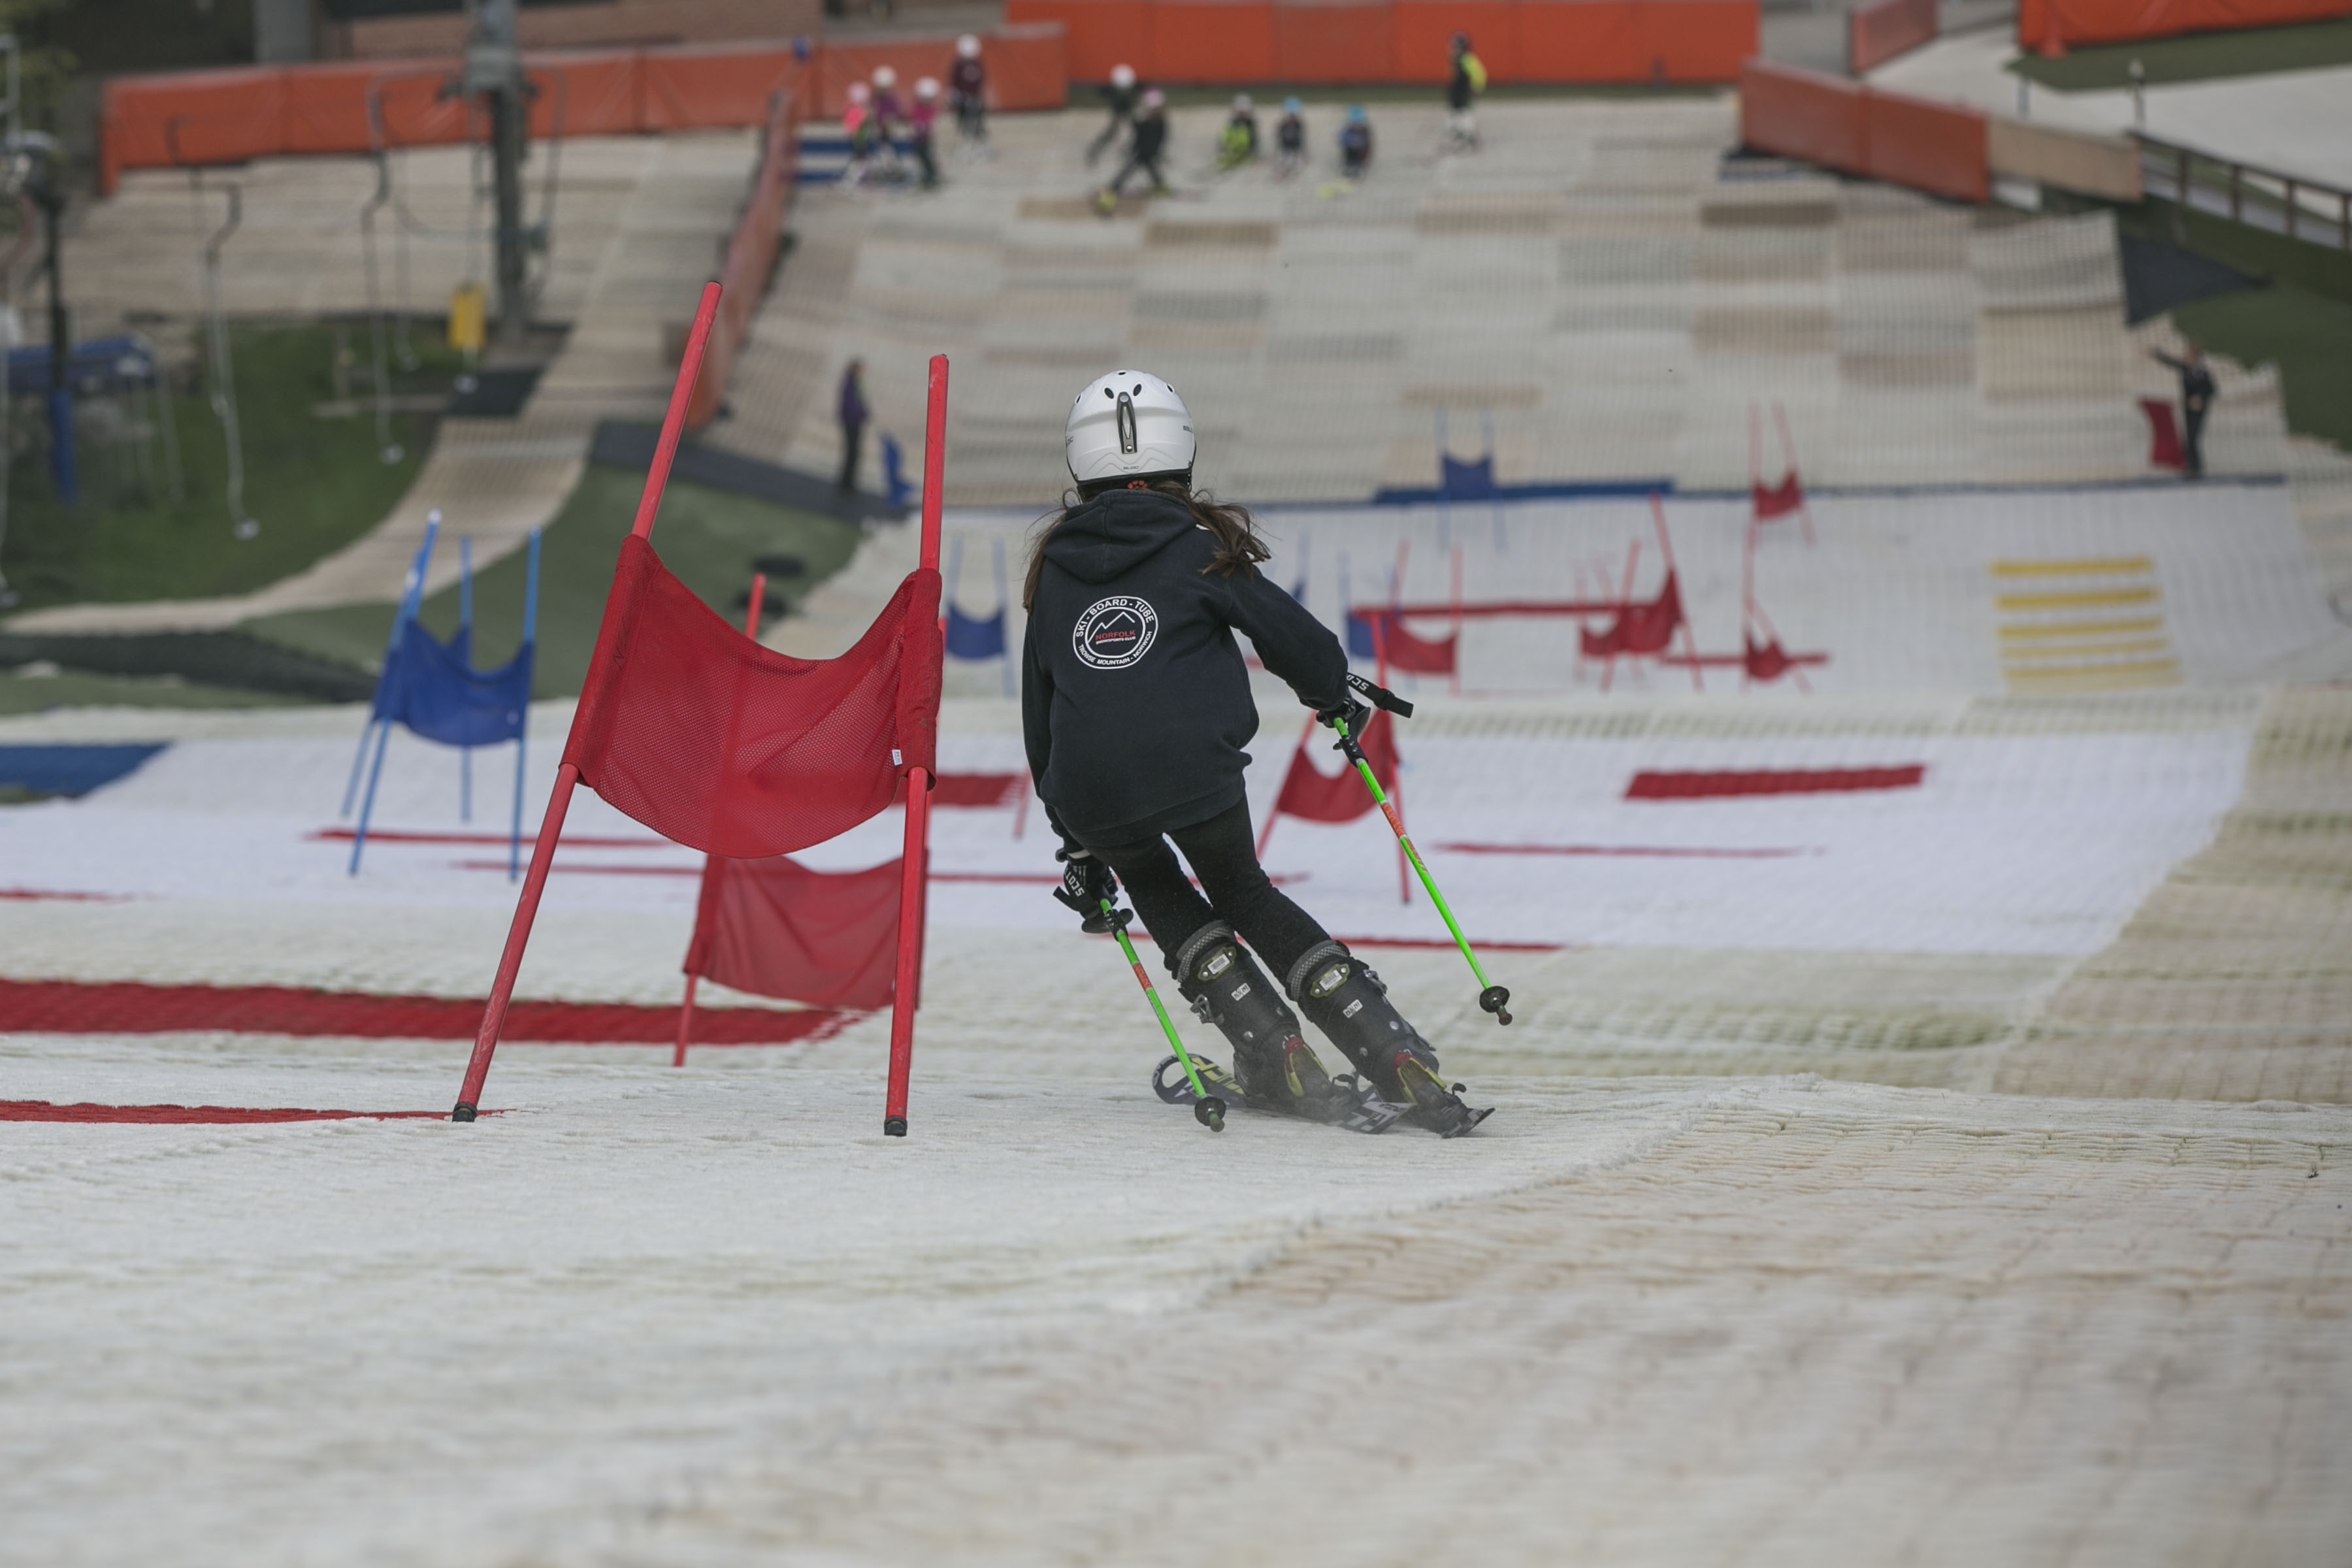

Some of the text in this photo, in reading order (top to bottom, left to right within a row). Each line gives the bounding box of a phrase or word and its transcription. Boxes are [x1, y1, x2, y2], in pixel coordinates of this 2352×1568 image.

[1076, 621, 1088, 637] SKI
[1089, 598, 1128, 616] BOARD
[1135, 600, 1154, 623] TUBE
[1078, 644, 1096, 662] TROWSE
[1133, 631, 1152, 658] NORWICH
[1094, 630, 1135, 641] NORFOLK
[1347, 674, 1369, 692] SCO
